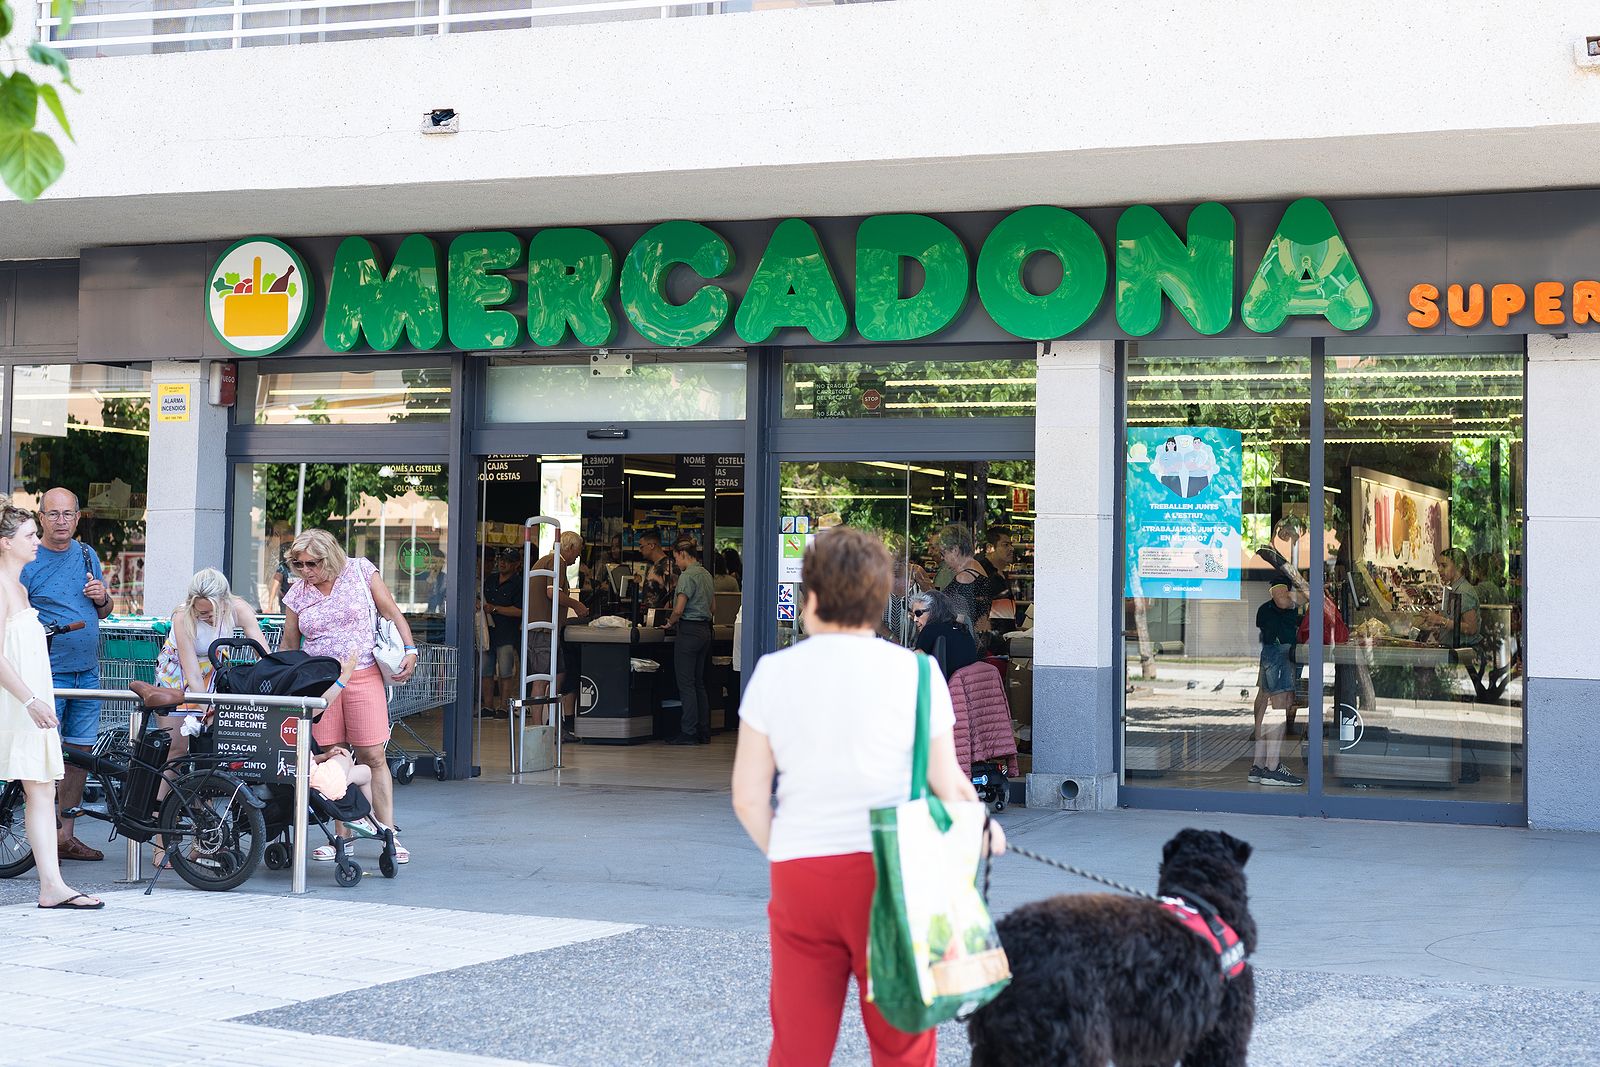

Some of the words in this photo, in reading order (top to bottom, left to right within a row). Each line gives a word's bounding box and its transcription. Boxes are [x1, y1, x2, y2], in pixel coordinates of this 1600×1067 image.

[322, 198, 1373, 354] MERCADONA
[1407, 281, 1600, 329] SUPER
[221, 375, 236, 383] UEGO
[683, 455, 705, 464] NOMÉ
[718, 457, 746, 465] CISTELL
[487, 462, 508, 470] CAJAS
[496, 472, 521, 480] CESTAS
[219, 711, 265, 720] CARRETONS
[235, 721, 267, 729] RECINTE
[231, 744, 257, 752] SACAR
